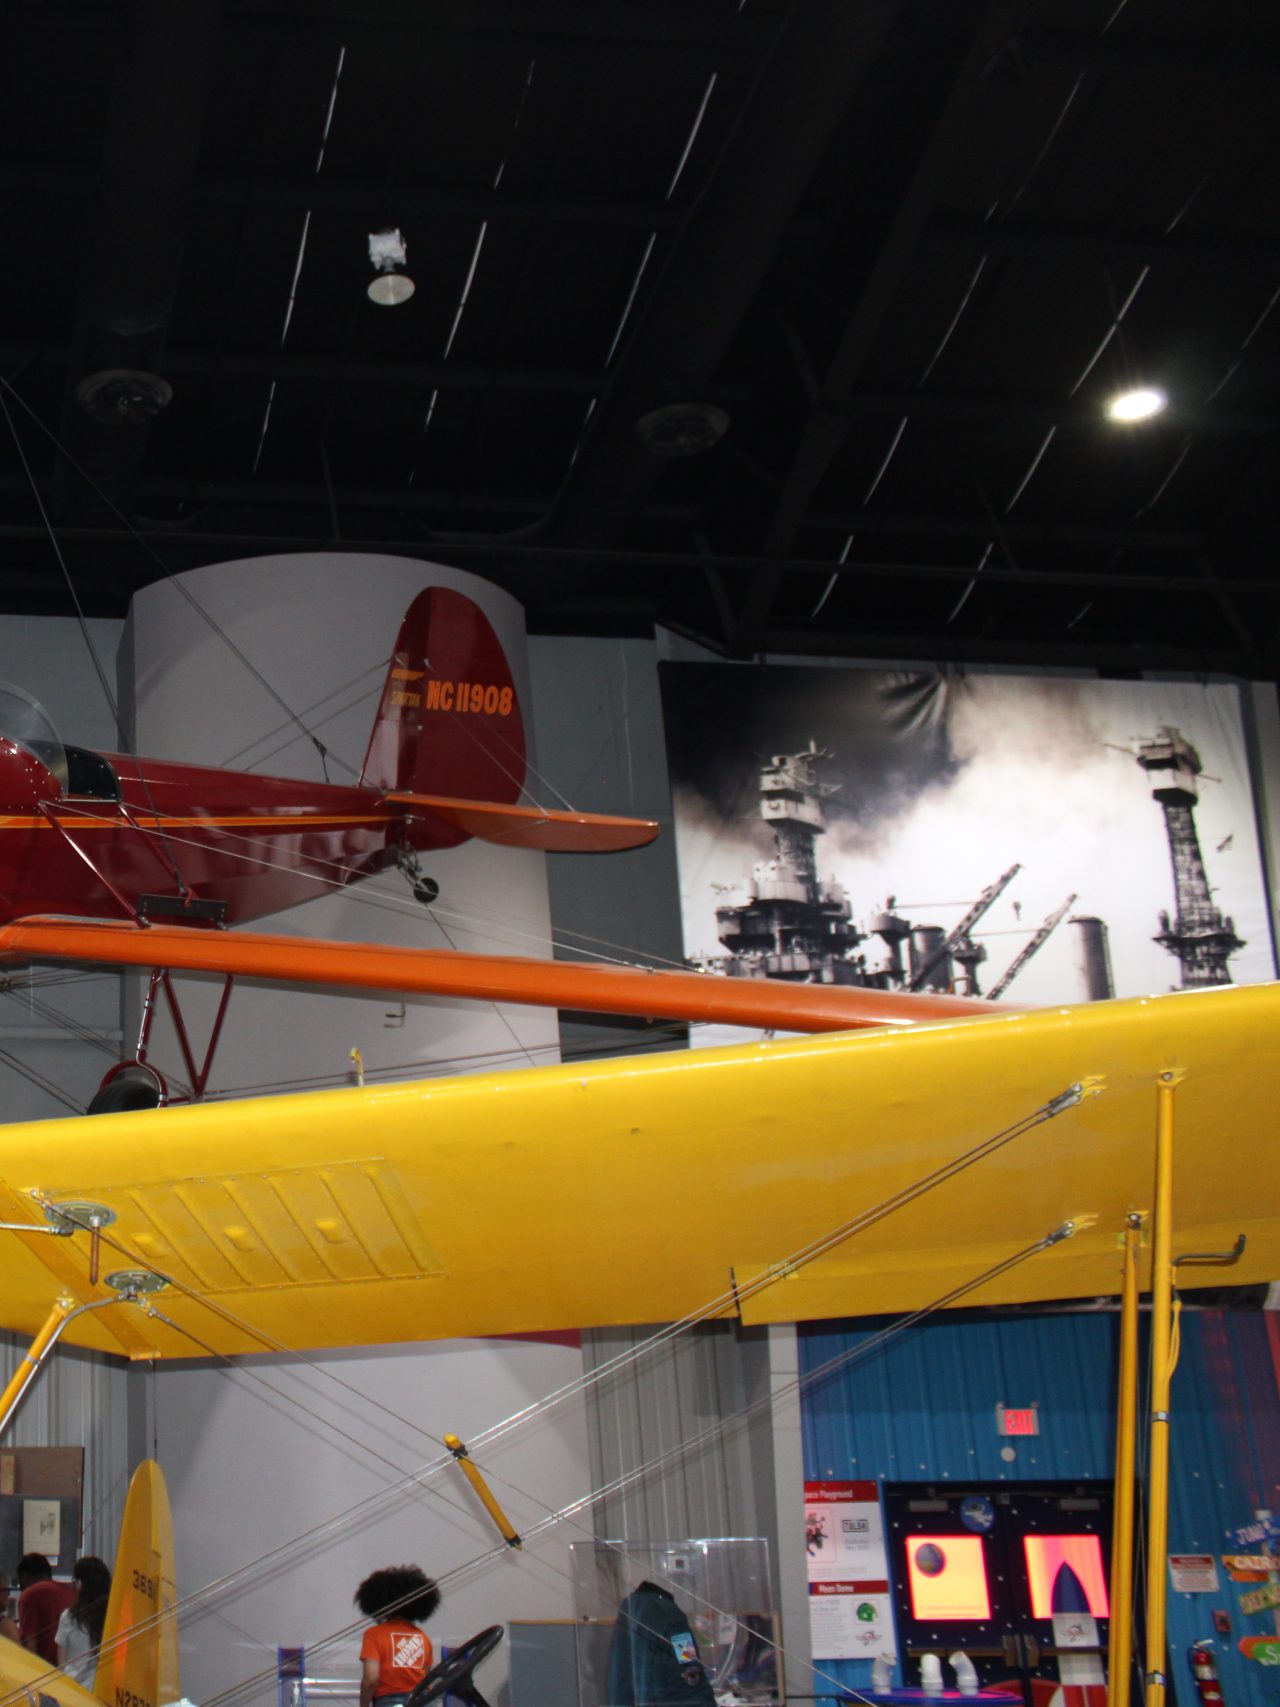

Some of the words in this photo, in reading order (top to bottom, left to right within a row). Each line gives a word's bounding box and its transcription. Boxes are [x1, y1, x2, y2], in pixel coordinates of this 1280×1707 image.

[426, 680, 454, 711] NC
[456, 682, 513, 716] 11908
[1005, 1409, 1033, 1435] EXIT
